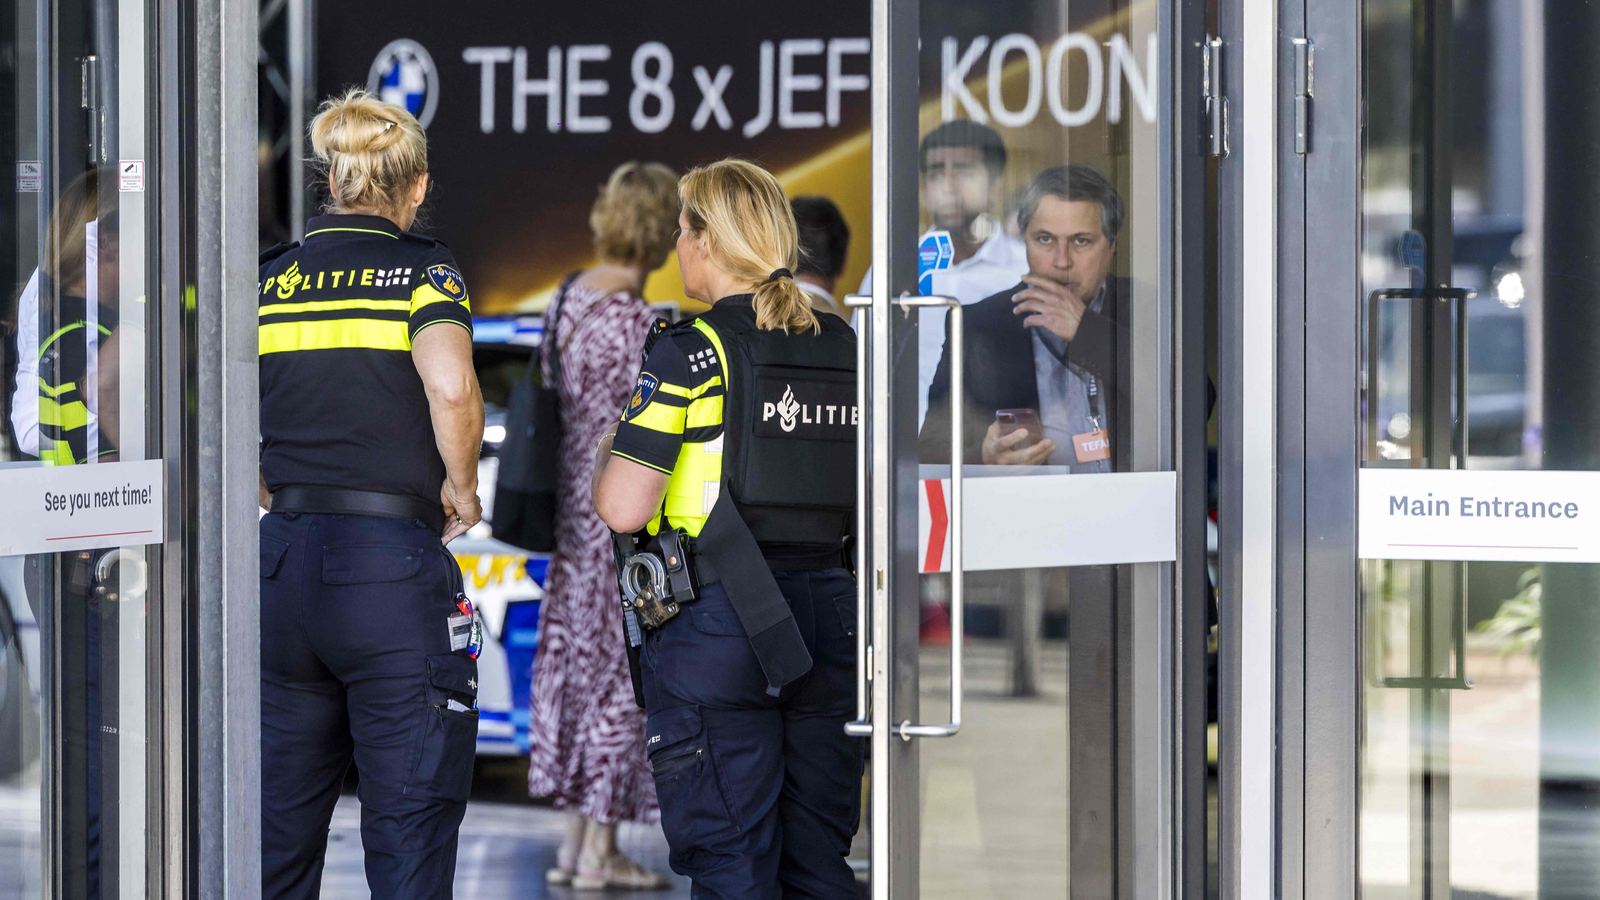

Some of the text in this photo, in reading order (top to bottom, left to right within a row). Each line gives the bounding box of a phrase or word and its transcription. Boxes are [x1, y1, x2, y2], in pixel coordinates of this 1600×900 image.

[462, 33, 1157, 138] THE 8 x JEF KOON
[263, 262, 375, 299] POLITIE
[762, 390, 858, 433] POLITIE
[45, 483, 152, 516] See you next time!
[1389, 493, 1579, 519] Main Entrance
